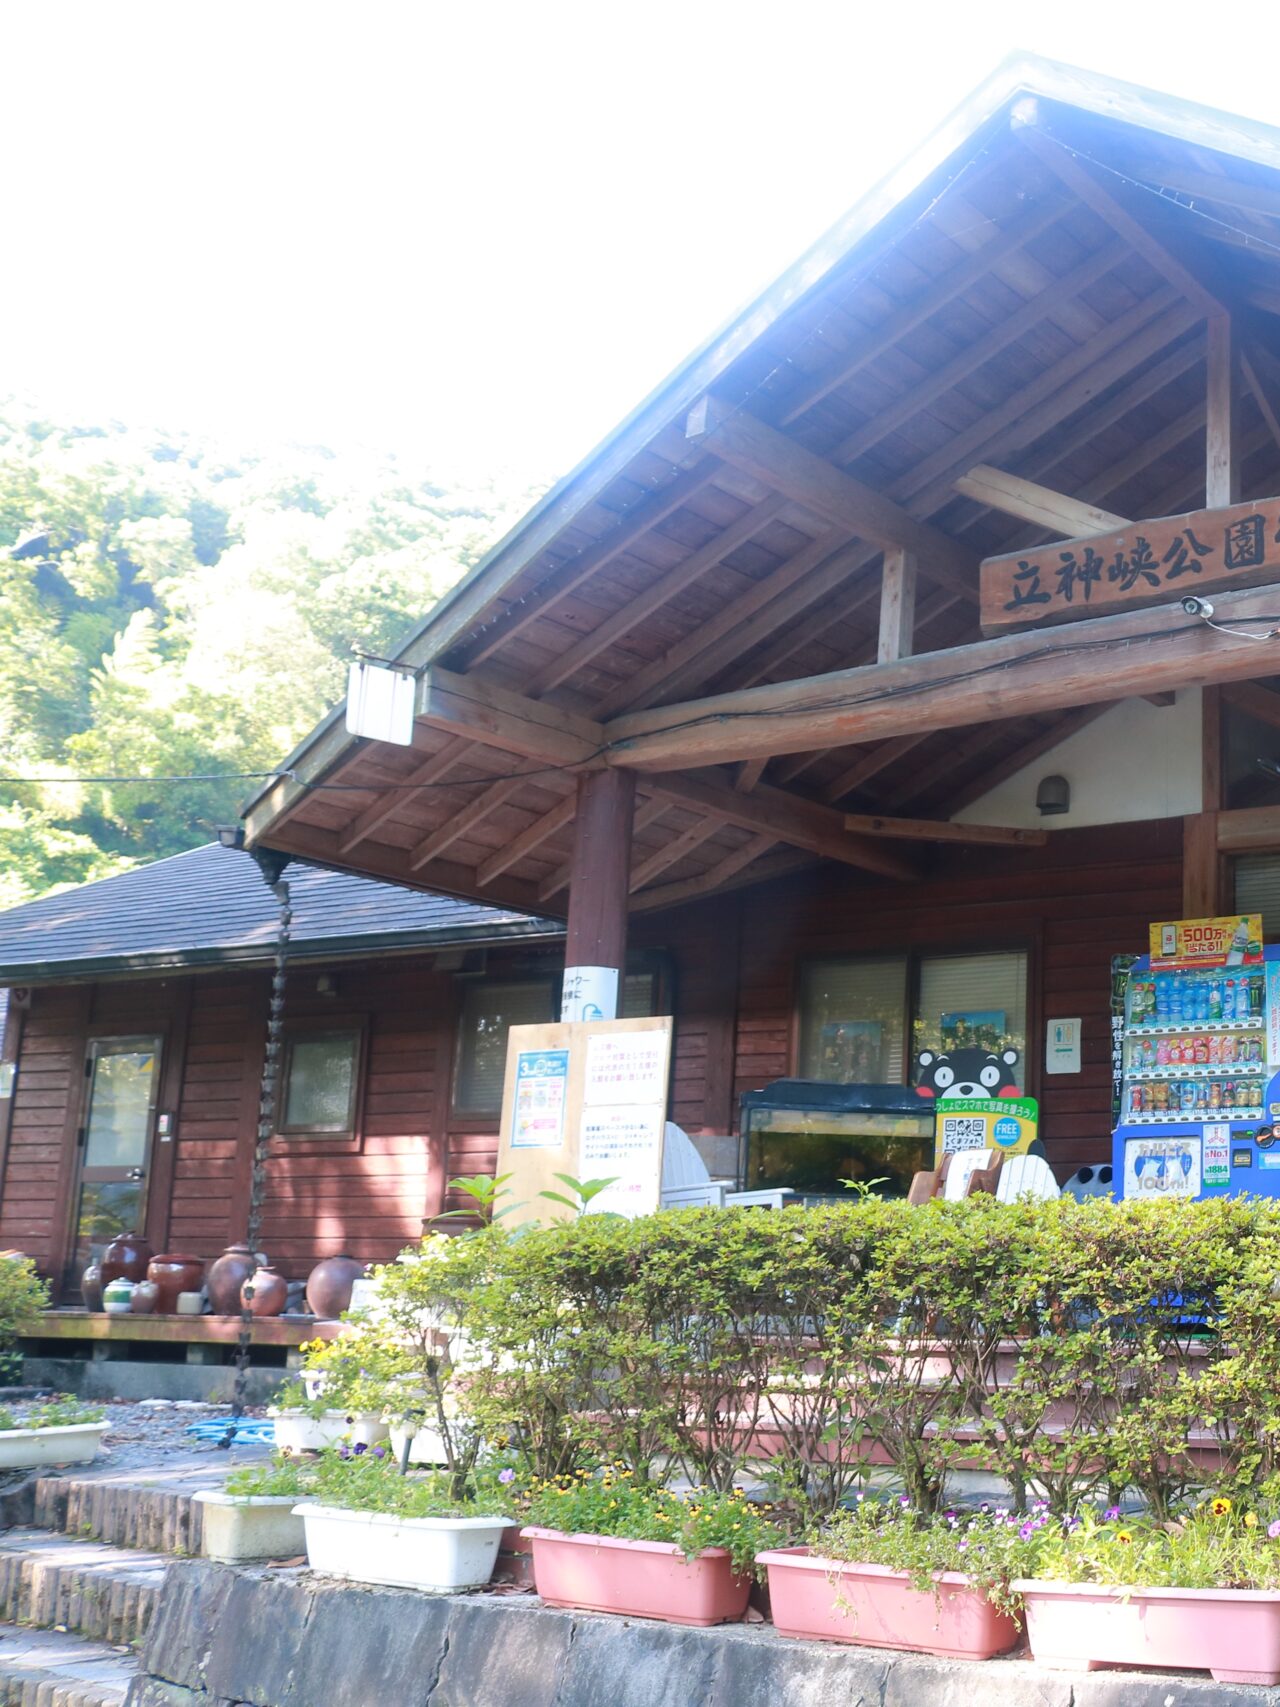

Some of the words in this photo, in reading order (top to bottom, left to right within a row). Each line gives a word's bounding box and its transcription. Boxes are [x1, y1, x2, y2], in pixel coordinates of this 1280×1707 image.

[996, 1123, 1017, 1134] FREE
[1210, 1149, 1228, 1158] No.1
[1208, 1165, 1228, 1174] 1884
